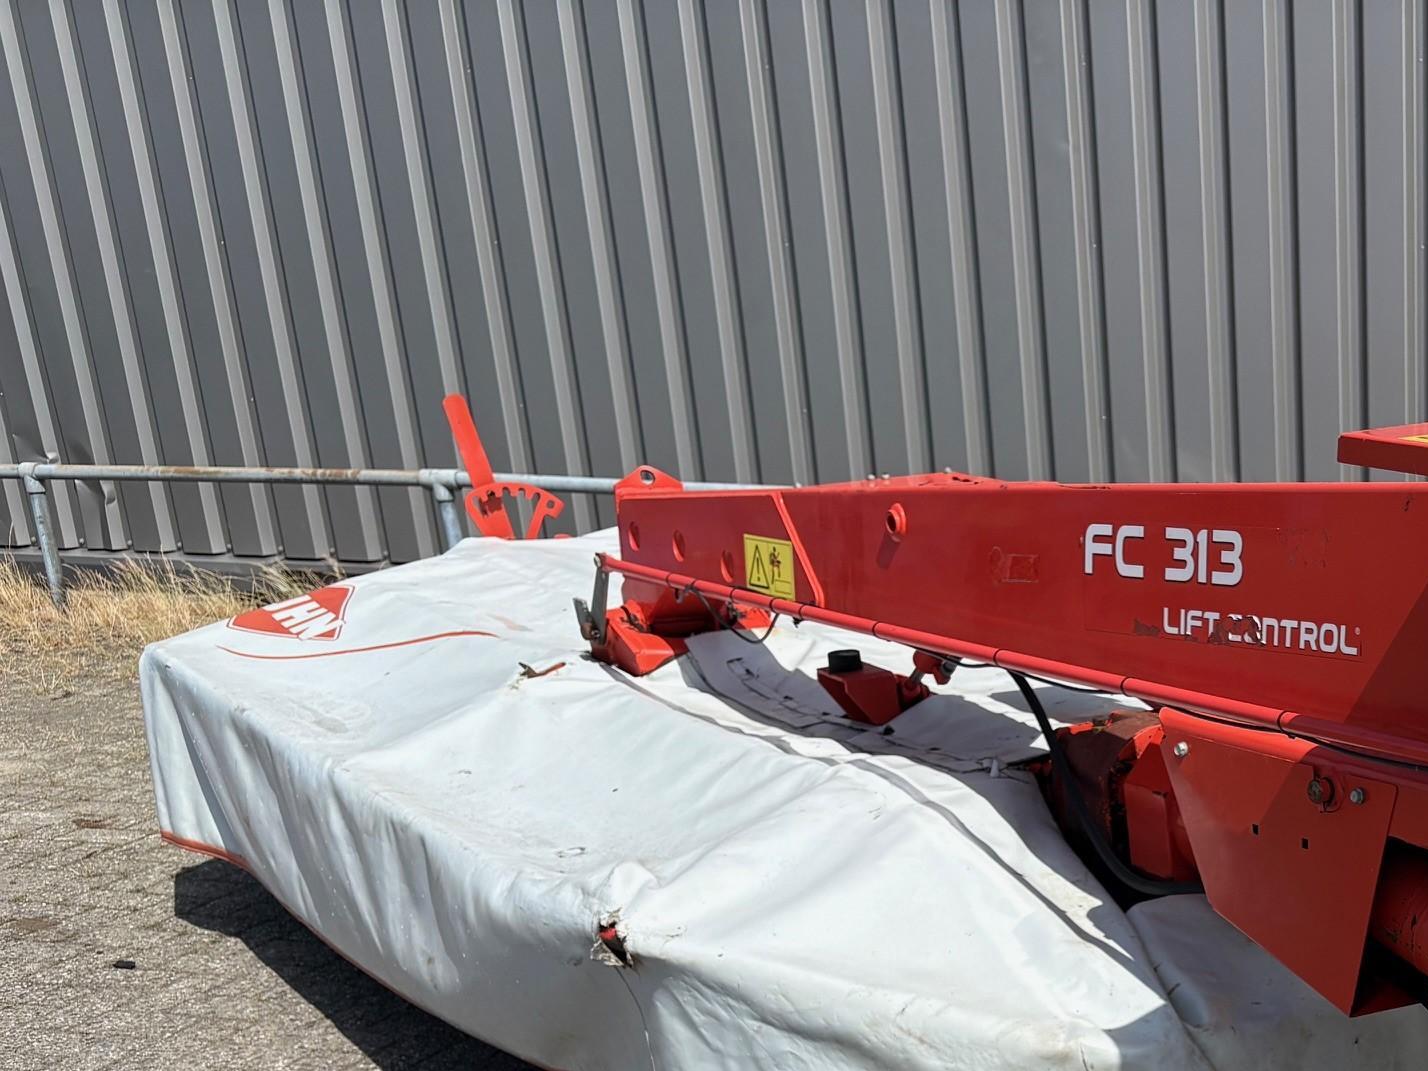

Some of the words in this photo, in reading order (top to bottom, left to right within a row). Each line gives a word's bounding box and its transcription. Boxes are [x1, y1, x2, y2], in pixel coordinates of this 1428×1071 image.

[1083, 522, 1146, 578] FC
[1163, 526, 1244, 586] 313
[1162, 607, 1221, 638] LIFT
